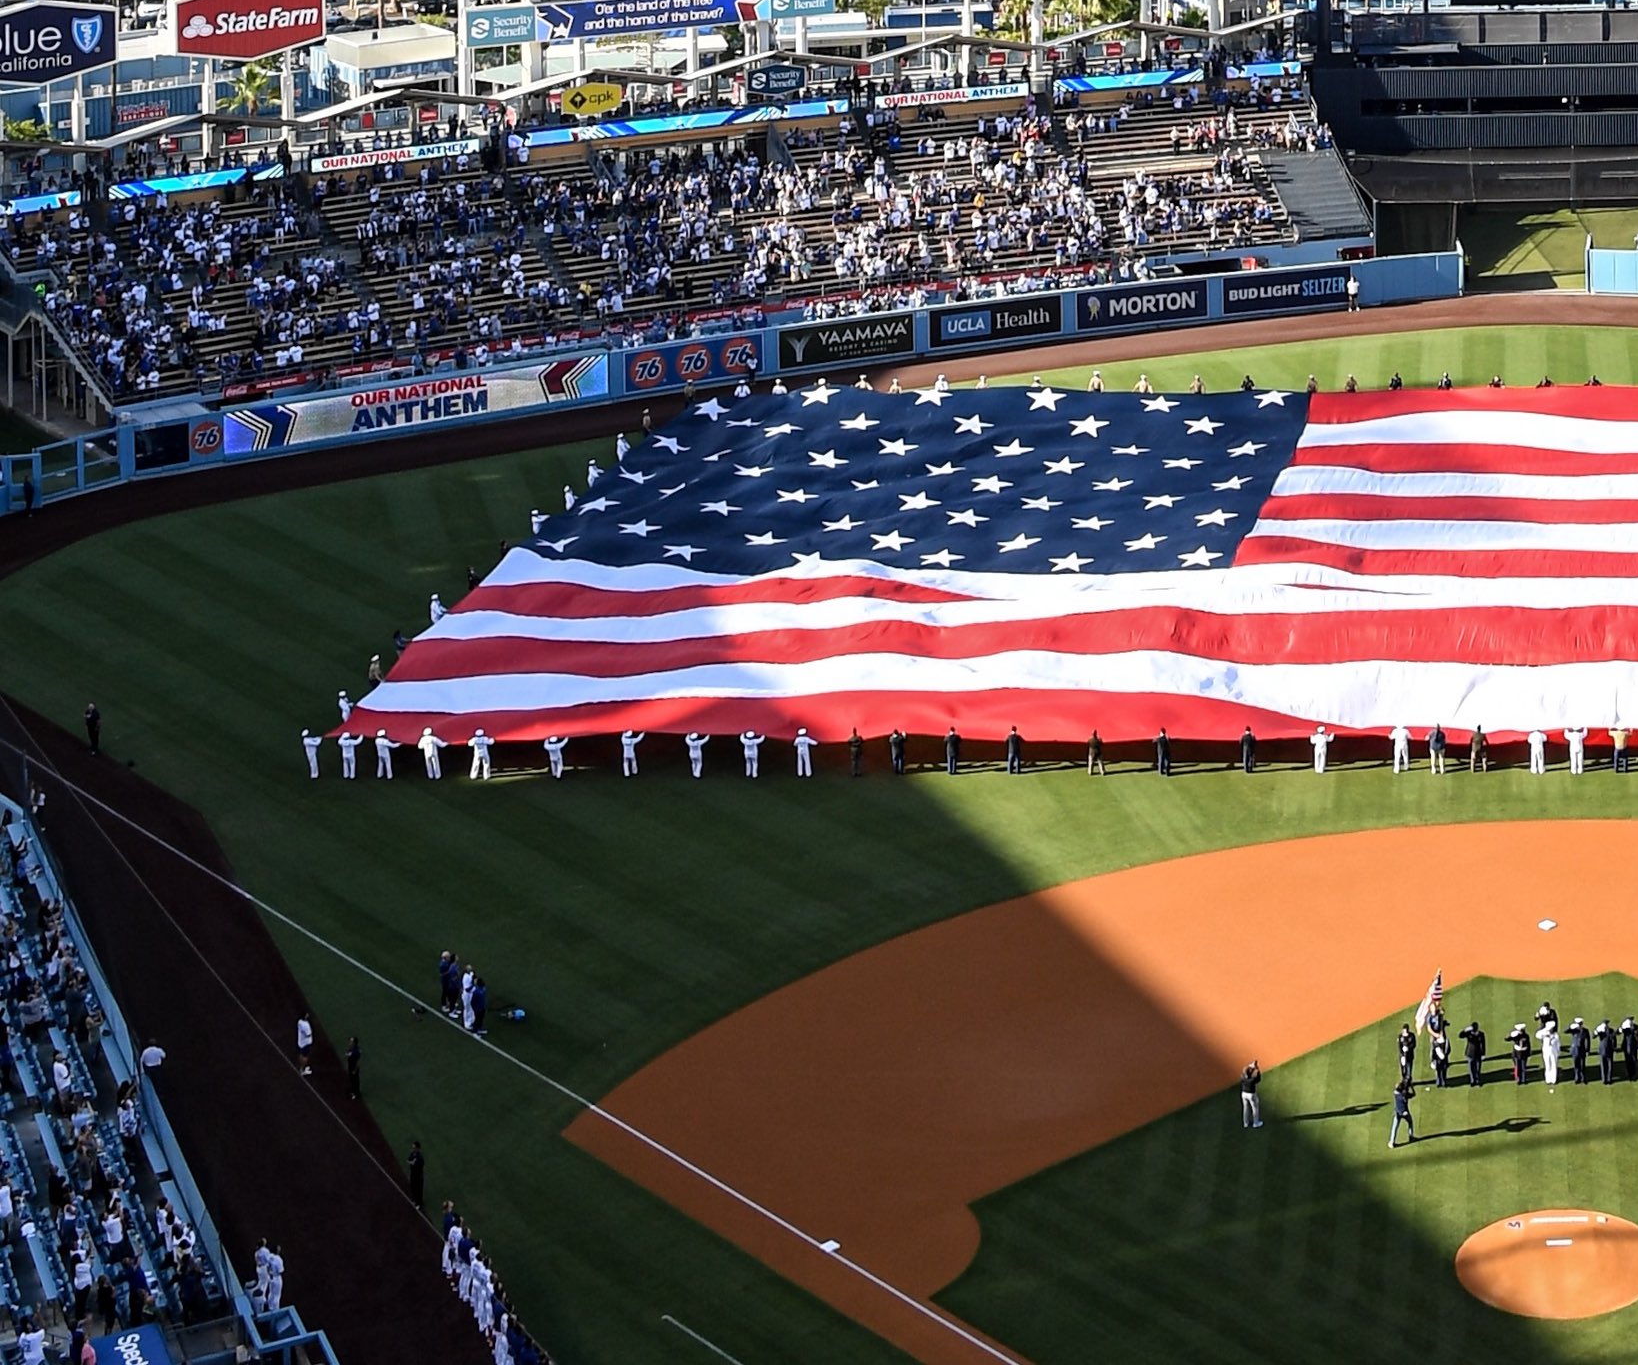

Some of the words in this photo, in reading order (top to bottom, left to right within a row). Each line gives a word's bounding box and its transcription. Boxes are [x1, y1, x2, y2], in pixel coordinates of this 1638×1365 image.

[584, 17, 604, 30] and
[606, 16, 624, 28] the
[626, 14, 655, 27] home
[657, 12, 669, 24] of
[671, 11, 688, 23] the
[690, 7, 724, 21] brave?
[617, 1, 634, 13] the
[636, 0, 658, 11] land
[493, 14, 533, 29] Security
[494, 25, 529, 39] Benefit
[0, 23, 62, 56] lue
[0, 52, 72, 73] alifornia
[768, 69, 800, 82] Security
[769, 78, 798, 90] Benefit
[588, 90, 614, 106] cpk
[884, 95, 909, 108] OUR
[910, 90, 969, 105] NATIONAL
[972, 85, 1020, 99] ANTHEM
[321, 156, 348, 169] OUR
[350, 148, 414, 166] NATIONAL
[418, 142, 469, 158] ANTHEM
[1228, 287, 1258, 303] BUD
[1259, 283, 1301, 299] LIGHT
[1302, 276, 1346, 297] SELTZER
[1108, 290, 1197, 318] MORTON
[818, 318, 909, 345] YAAMAVA'
[947, 316, 986, 334] UCLA
[995, 307, 1051, 331] Health
[681, 347, 708, 374] 76
[725, 341, 752, 366] 76
[635, 356, 662, 382] 76
[351, 388, 391, 408] OUR
[394, 374, 486, 402] NATIONAL
[351, 390, 488, 433] ANTHEM
[194, 425, 220, 449] 76
